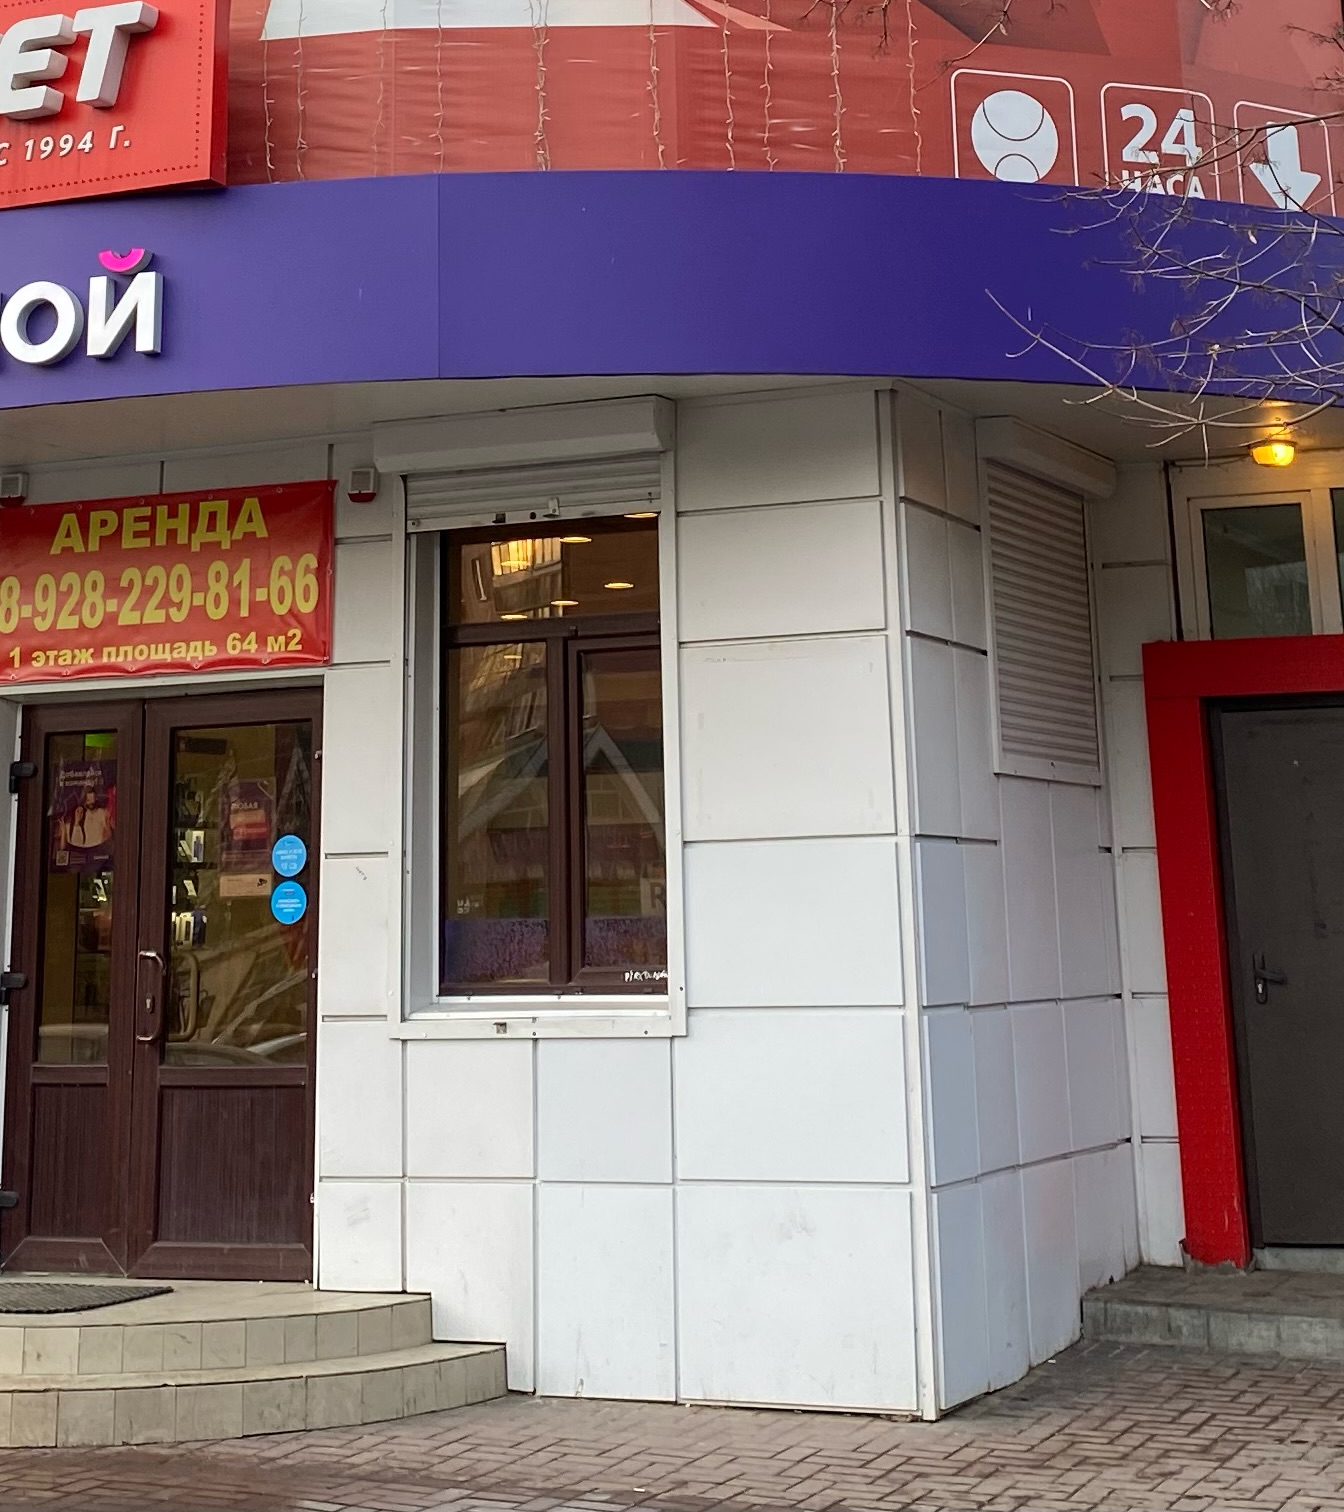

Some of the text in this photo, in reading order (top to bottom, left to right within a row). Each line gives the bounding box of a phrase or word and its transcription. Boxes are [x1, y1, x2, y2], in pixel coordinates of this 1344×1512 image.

[24, 130, 94, 161] 1994
[1120, 103, 1202, 168] 24
[50, 498, 268, 555] АРЕНДА
[9, 628, 302, 668] 1 этаж площадь 64 м2
